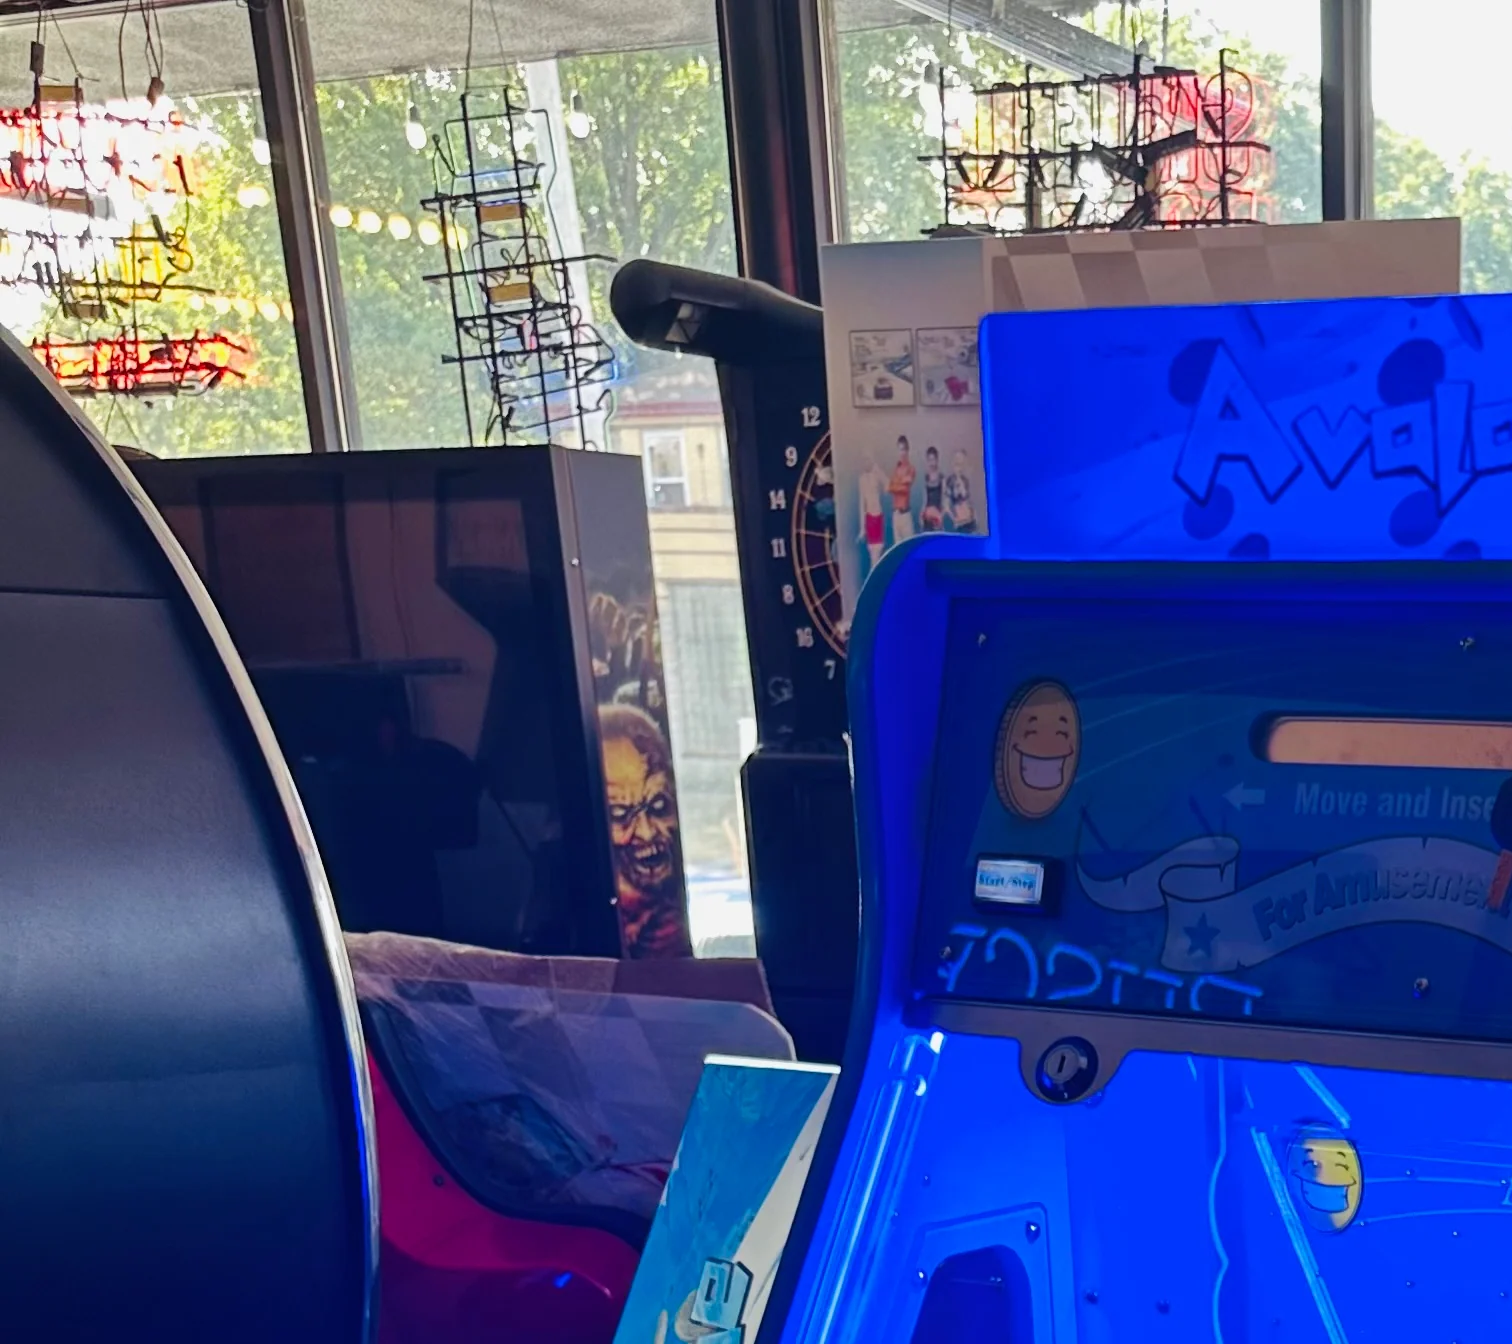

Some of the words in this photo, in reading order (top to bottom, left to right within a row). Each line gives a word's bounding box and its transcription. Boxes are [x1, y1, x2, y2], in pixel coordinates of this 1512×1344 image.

[801, 406, 821, 428] 12
[785, 446, 798, 468] 9
[769, 489, 787, 510] 14
[771, 538, 787, 558] 11
[824, 660, 836, 680] 7
[1294, 781, 1368, 817] Move
[1377, 786, 1431, 819] and
[1440, 786, 1496, 822] Inse
[1252, 888, 1310, 943] For
